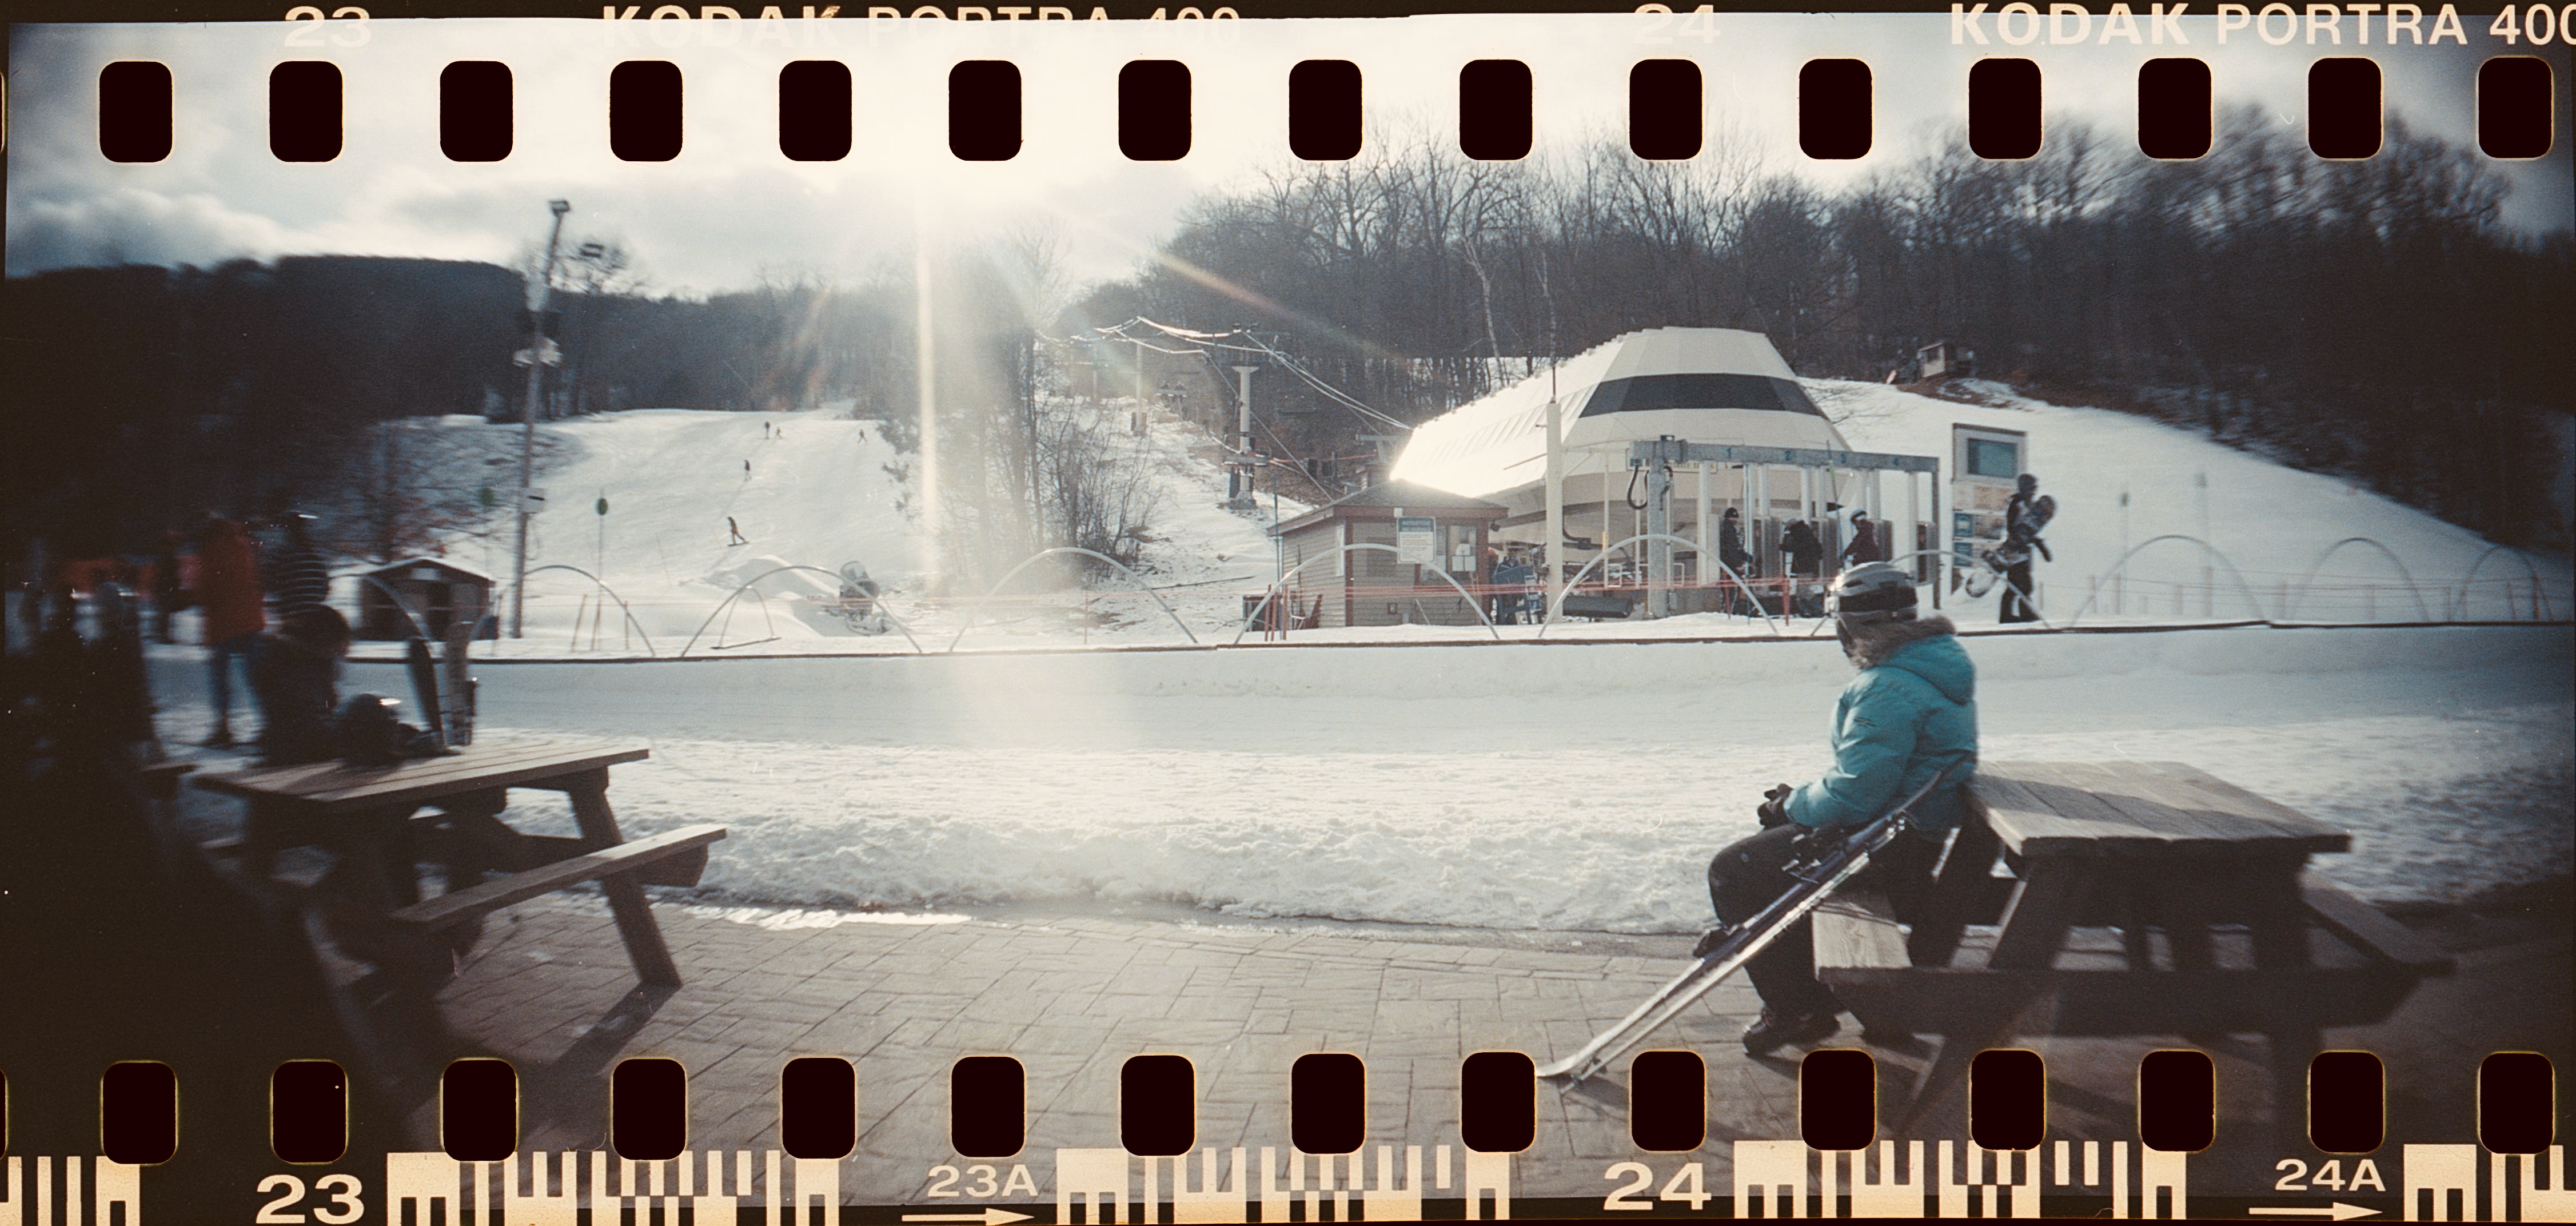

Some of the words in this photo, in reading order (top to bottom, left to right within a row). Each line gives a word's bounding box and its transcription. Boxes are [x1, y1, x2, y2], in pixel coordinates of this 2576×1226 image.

[285, 6, 372, 47] 23
[603, 5, 841, 47] KODAK
[1632, 3, 1721, 44] 24
[1951, 2, 2190, 45] KODAK
[2218, 3, 2468, 45] PORTRA
[928, 1164, 1038, 1197] 23A
[1604, 1162, 1712, 1210] 24
[2275, 1159, 2386, 1191] 24A
[256, 1174, 364, 1224] 23
